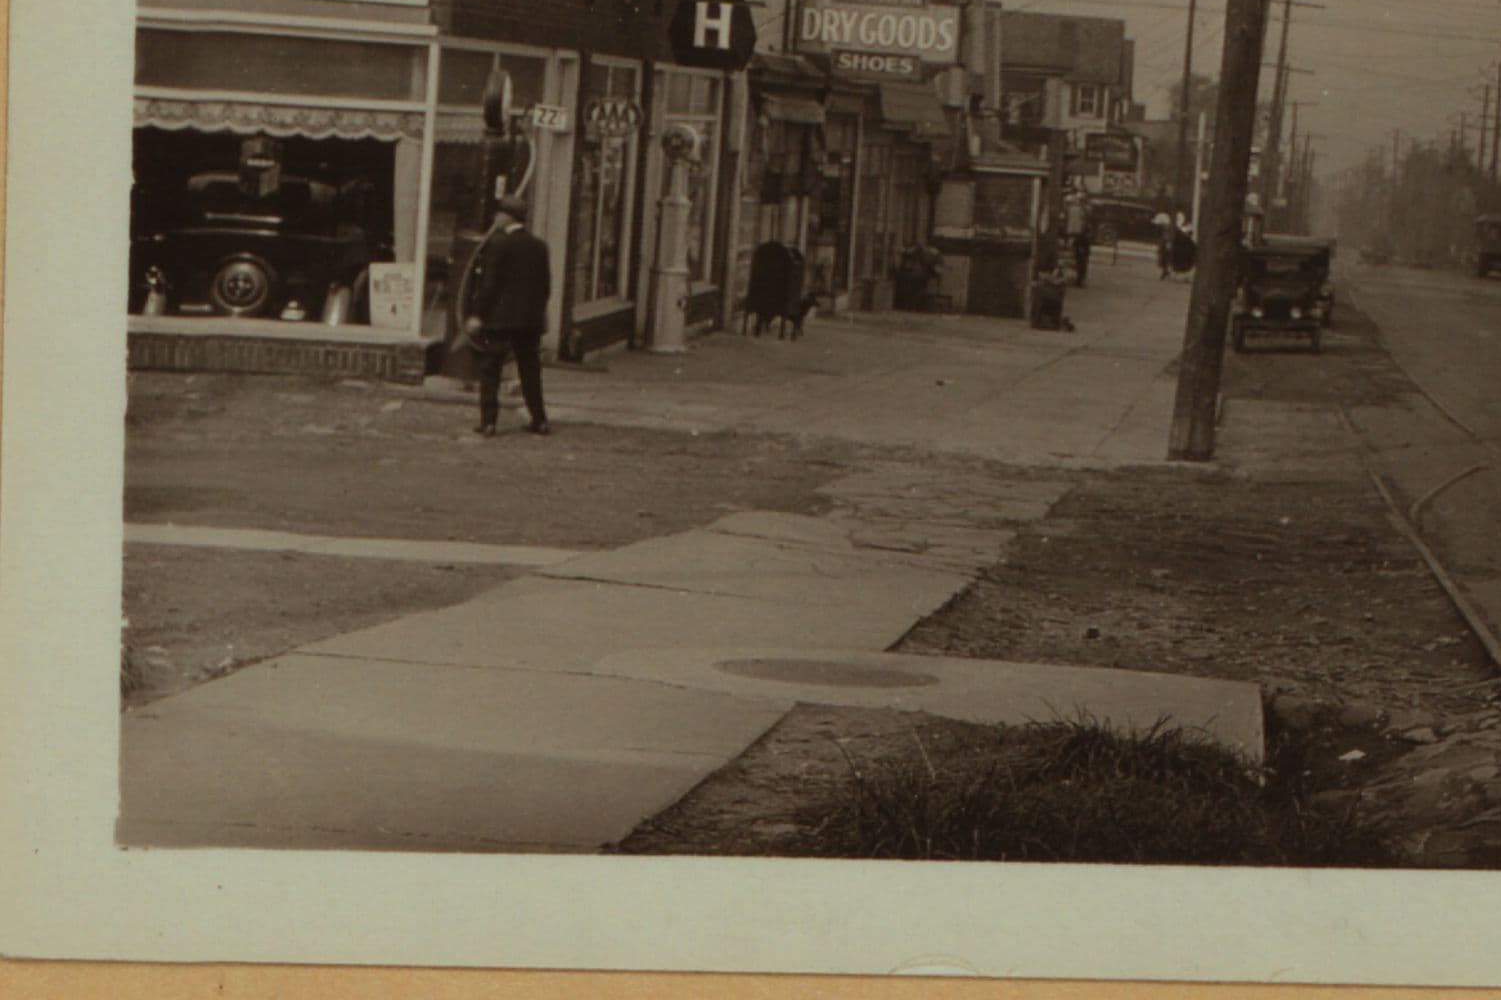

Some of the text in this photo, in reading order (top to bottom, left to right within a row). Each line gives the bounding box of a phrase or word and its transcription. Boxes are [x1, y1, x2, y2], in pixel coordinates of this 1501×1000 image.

[802, 8, 953, 52] DRY GOODS
[837, 53, 914, 75] SHOES
